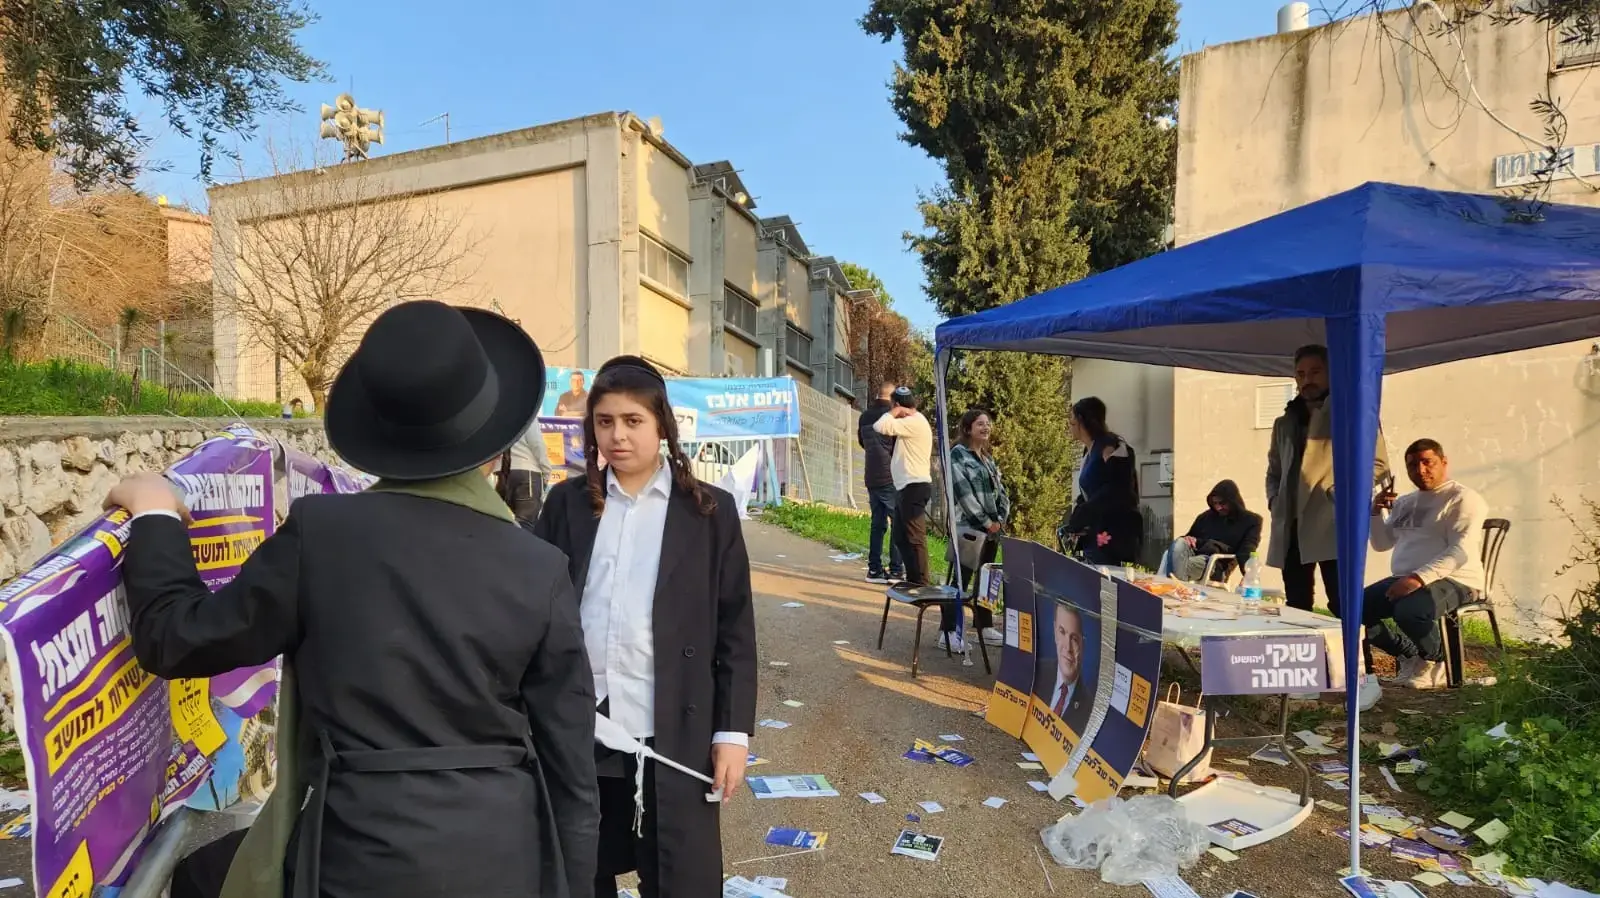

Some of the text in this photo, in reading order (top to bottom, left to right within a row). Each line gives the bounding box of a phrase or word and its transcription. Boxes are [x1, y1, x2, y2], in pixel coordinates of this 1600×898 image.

[30, 609, 97, 703] תנצח!
[1251, 667, 1319, 688] אוחנה
[1265, 643, 1317, 668] שוקי
[54, 697, 105, 761] לתושב
[1032, 704, 1075, 756] הכי טוב לצפת!
[1084, 754, 1119, 792] הכי טוב לצפ
